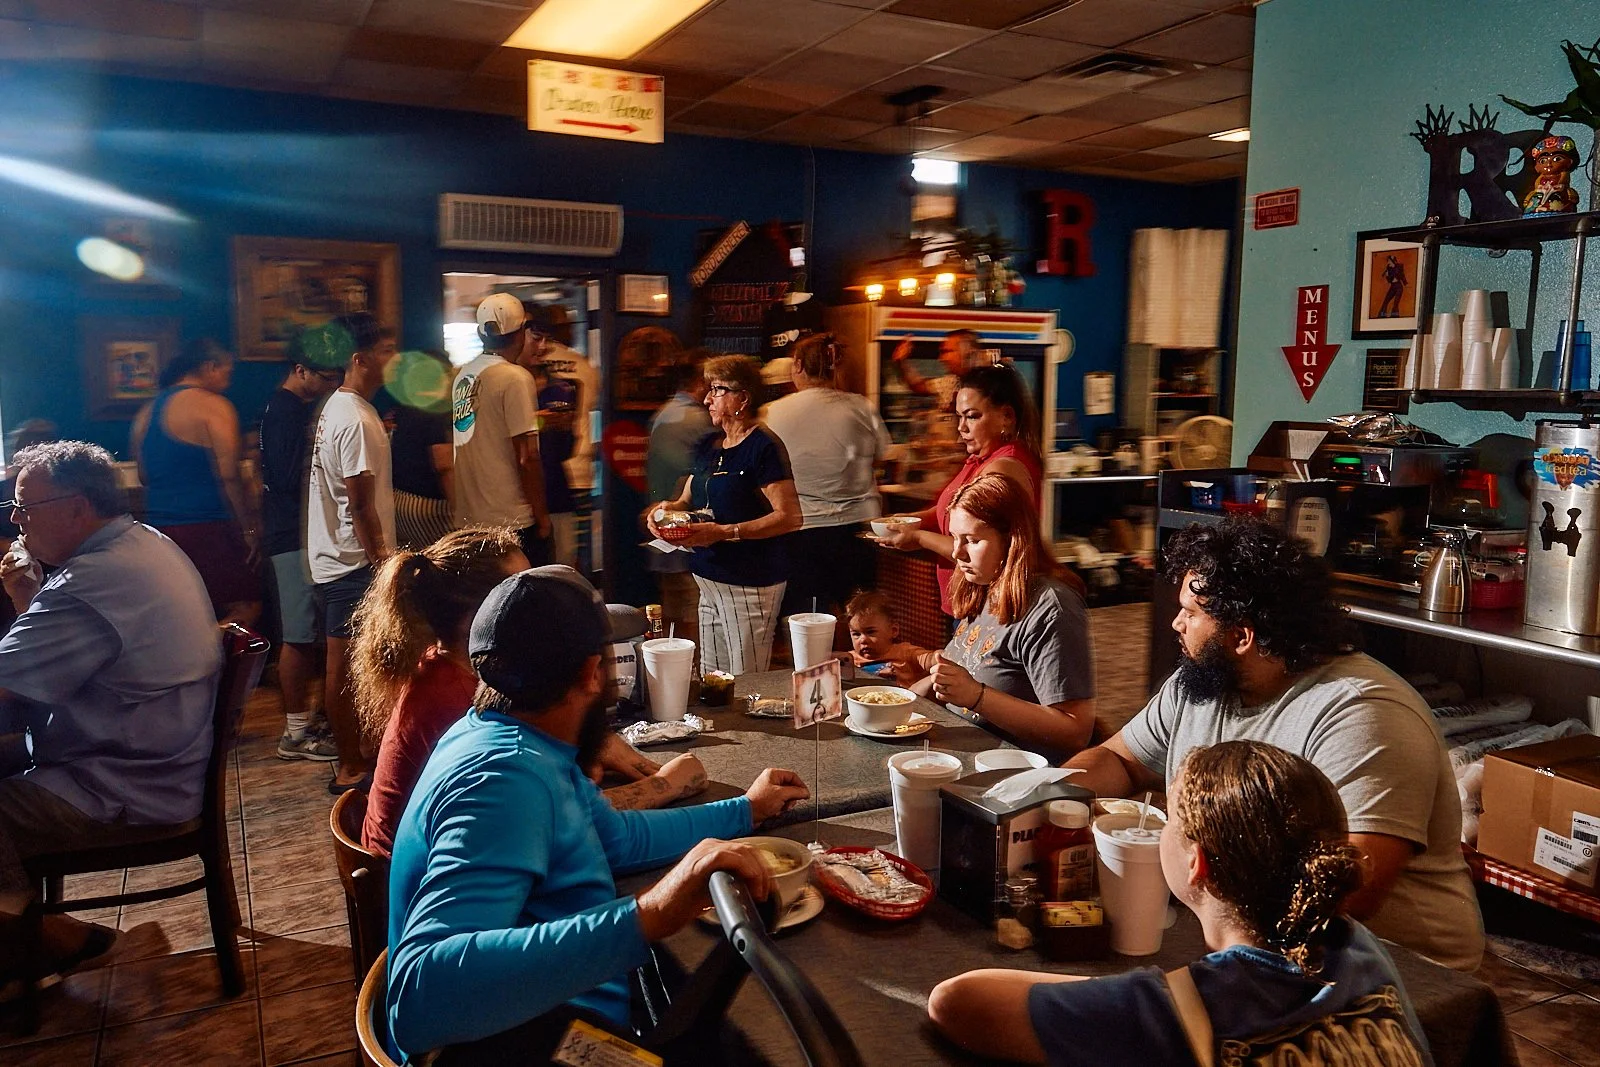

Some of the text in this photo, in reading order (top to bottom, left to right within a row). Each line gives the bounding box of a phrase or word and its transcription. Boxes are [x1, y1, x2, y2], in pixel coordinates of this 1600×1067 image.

[1040, 188, 1098, 277] R
[699, 247, 728, 281] ORDER
[1301, 288, 1323, 388] MENUS
[1546, 464, 1587, 476] iced tea
[615, 654, 635, 664] DER
[809, 678, 823, 705] 4
